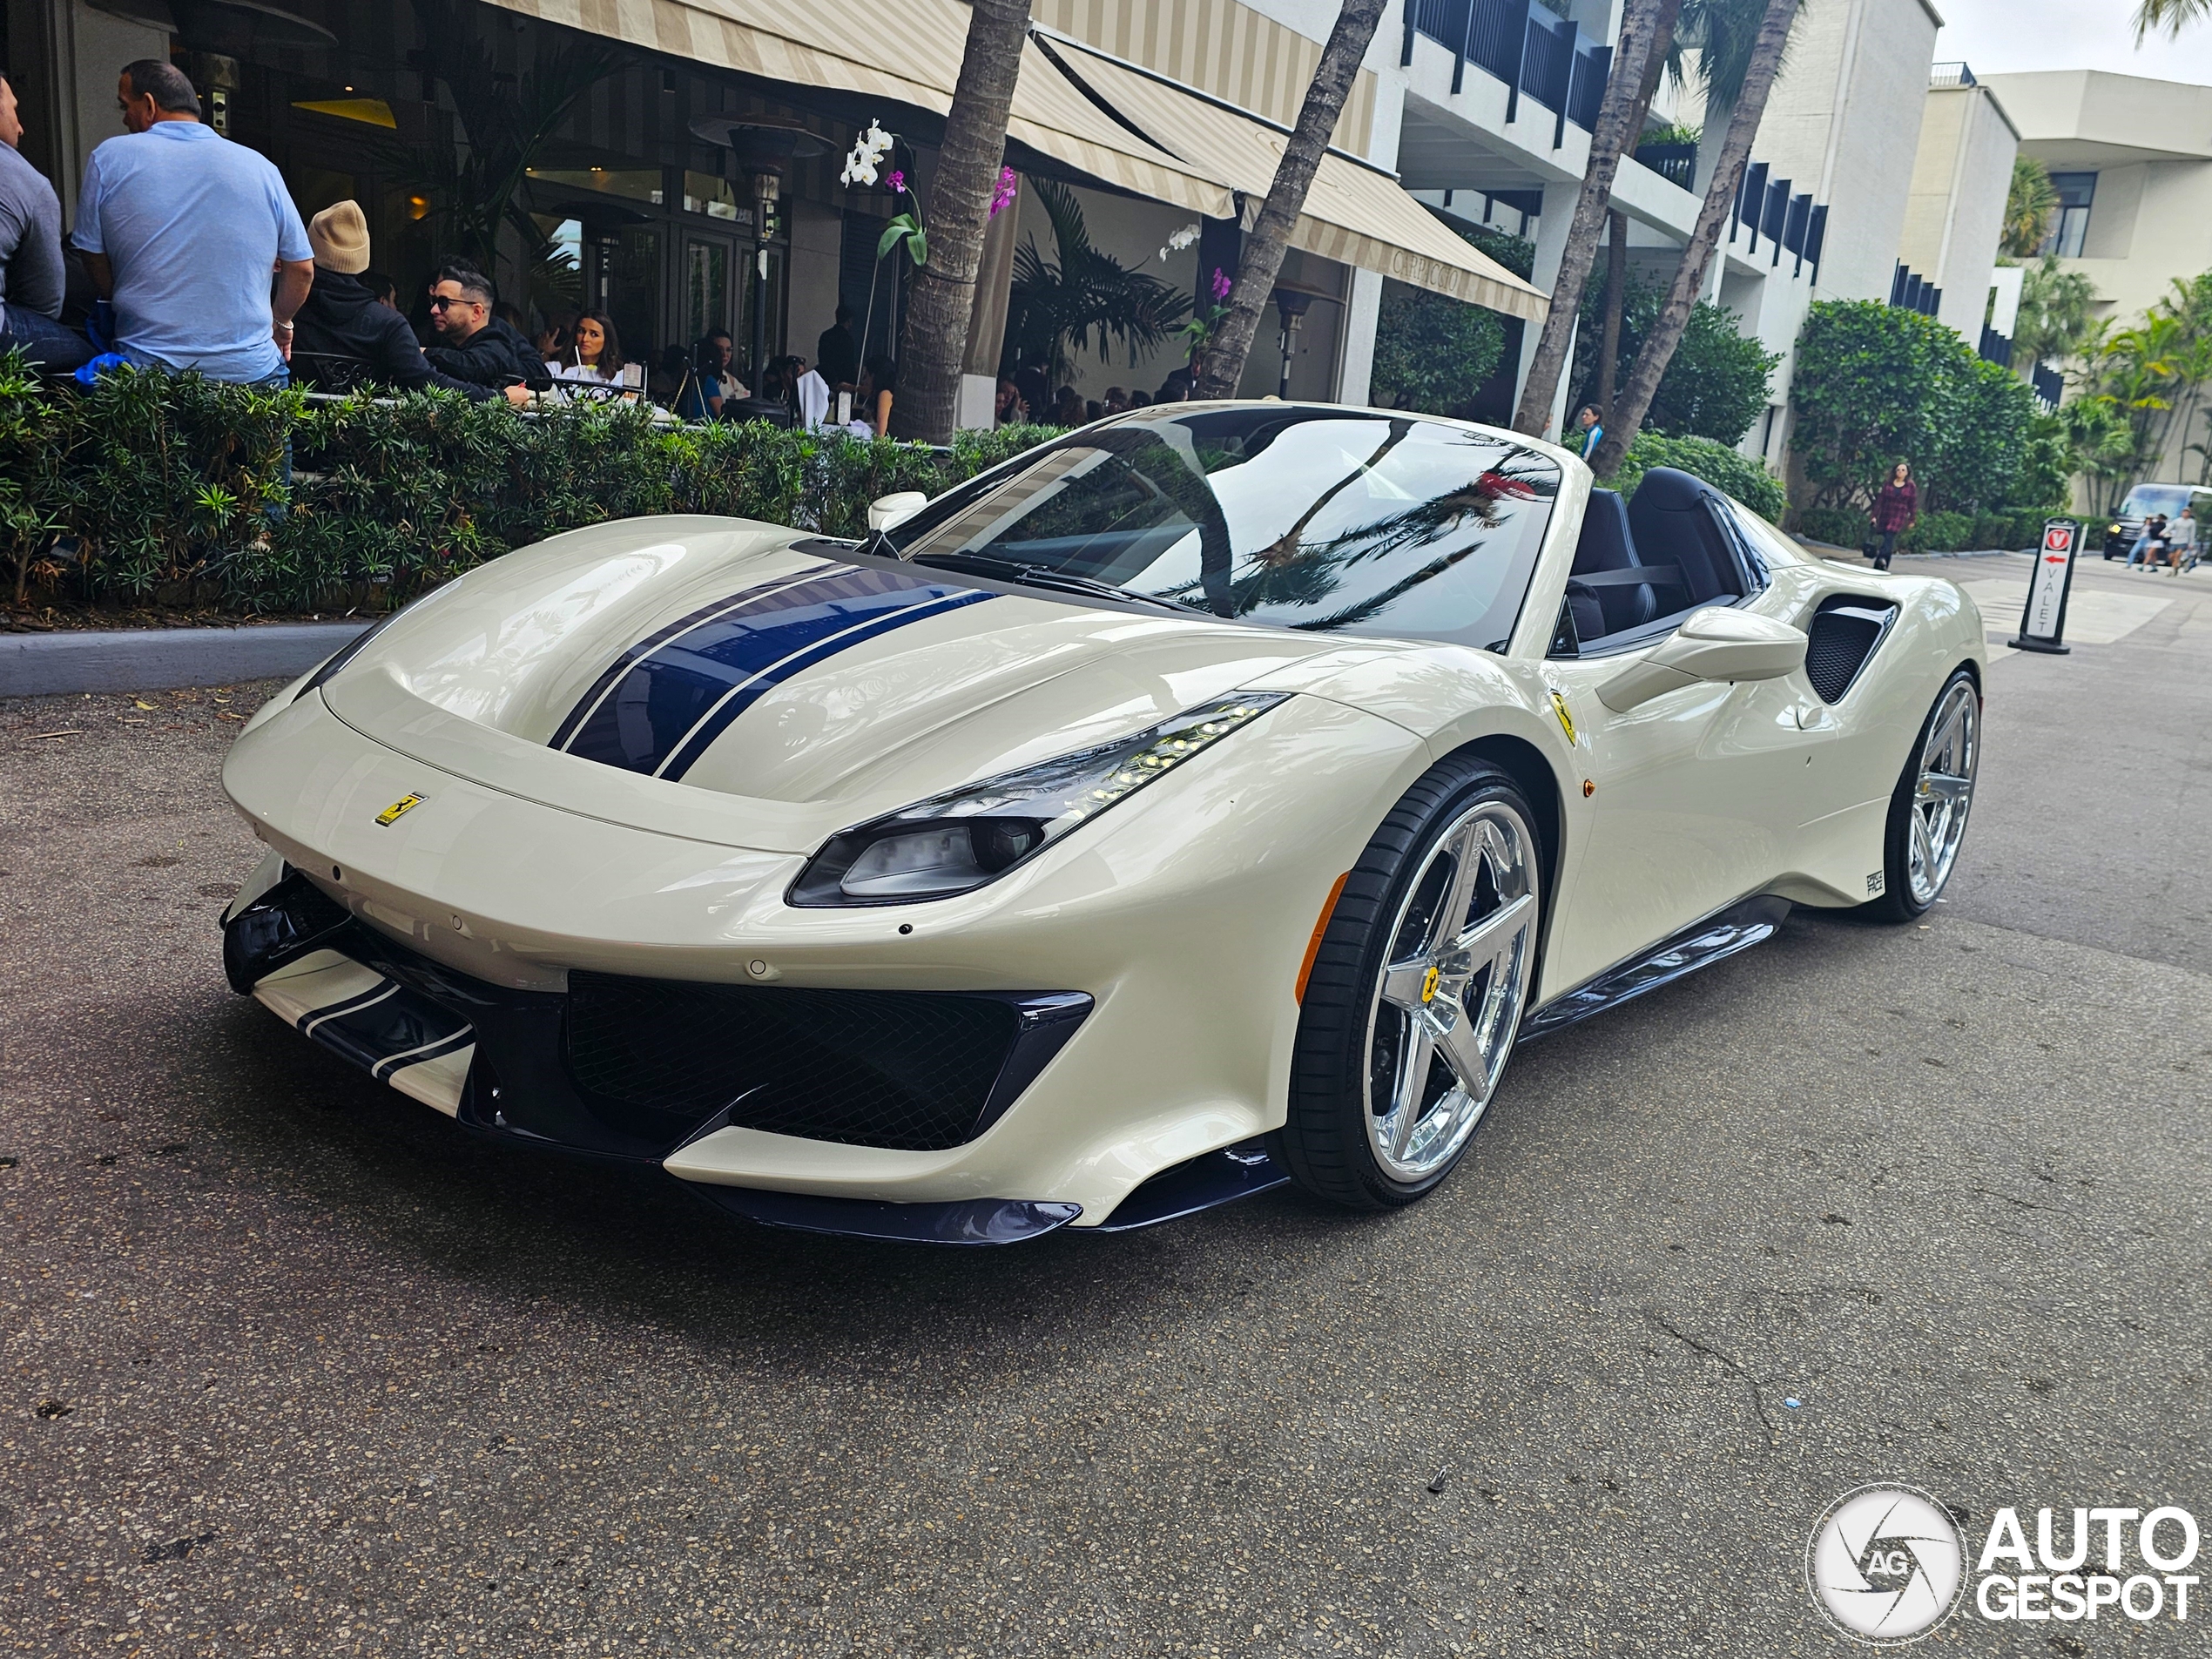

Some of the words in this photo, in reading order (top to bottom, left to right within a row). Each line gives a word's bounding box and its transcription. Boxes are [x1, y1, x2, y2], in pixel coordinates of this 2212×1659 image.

[2052, 532, 2067, 547] V
[2038, 568, 2057, 631] VALET
[1350, 972, 1369, 1068] MICHELIN
